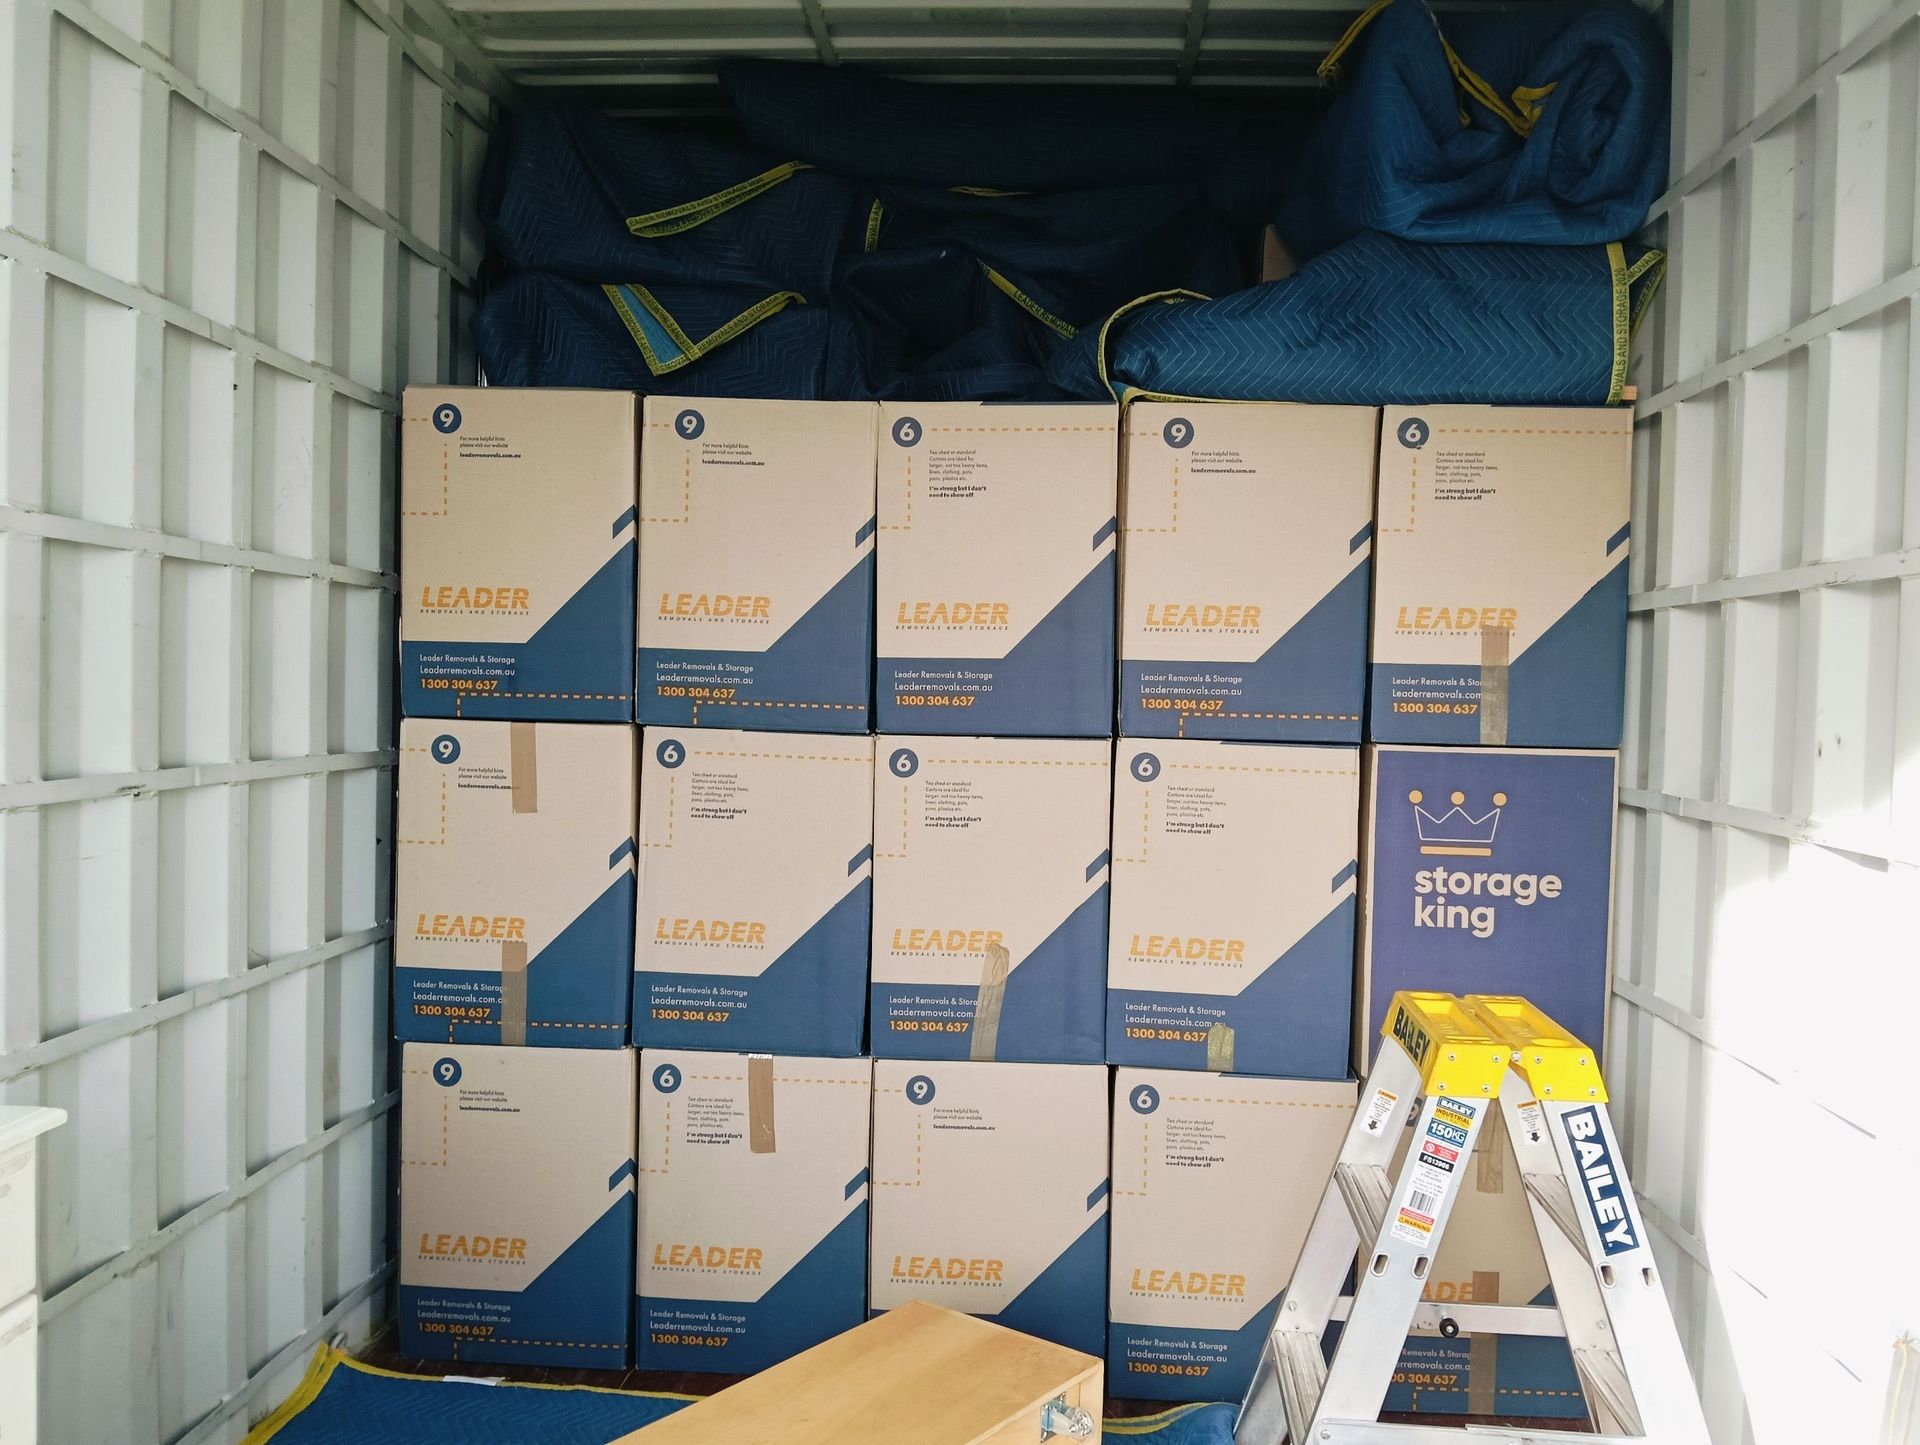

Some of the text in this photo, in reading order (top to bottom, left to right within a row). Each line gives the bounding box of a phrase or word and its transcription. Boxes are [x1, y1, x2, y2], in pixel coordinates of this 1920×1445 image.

[654, 202, 697, 220] REMOVALS
[714, 184, 748, 201] STORAGE
[1616, 267, 1628, 358] AND STORAGE 2020
[440, 409, 454, 427] 9
[683, 415, 697, 434] 9
[900, 422, 914, 441] 6
[1171, 424, 1186, 442] 9
[1406, 423, 1421, 442] 6
[422, 586, 529, 609] LEADER
[660, 593, 770, 618] LEADER
[898, 601, 1009, 625] LEADER
[1146, 604, 1261, 627] LEADER
[420, 654, 443, 662] Leader
[445, 654, 478, 663] Removals
[487, 656, 515, 665] Storage
[656, 661, 680, 670] Leader
[682, 662, 716, 671] Removals
[725, 664, 754, 674] Storage
[420, 666, 516, 676] Leaderremovals.com.au
[656, 673, 754, 684] Leaderremovals.com.au
[894, 670, 993, 681] Leader Removals & Storage
[1141, 673, 1166, 682] Leader
[1168, 674, 1203, 682] Removals
[1213, 675, 1243, 685] Storage
[421, 679, 498, 690] 1300 304 637
[657, 686, 735, 698] 1300 304 637
[895, 681, 993, 693] Leaderremovals.com.au
[1141, 685, 1243, 696] Leaderremovals.com.au
[896, 696, 975, 706] 1300 304 637
[1142, 699, 1223, 710] 1300 304 637
[1393, 703, 1478, 714] 1300 304 637
[439, 740, 453, 758] 9
[664, 744, 678, 763] 6
[897, 754, 911, 772] 6
[1138, 758, 1153, 776] 6
[1414, 866, 1562, 906] storage
[1414, 896, 1495, 938] king
[417, 914, 525, 938] LEADER
[657, 918, 766, 943] LEADER
[1131, 934, 1244, 962] LEADER
[651, 984, 675, 993] Leader
[677, 986, 711, 995] Removals
[720, 988, 748, 998] Storage
[651, 996, 748, 1009] Leaderremovals.com.au
[1125, 1002, 1226, 1018] Leader Removals & Storage
[414, 1005, 490, 1017] 1300 304 637
[652, 1009, 729, 1022] 1300 304 637
[890, 1021, 969, 1032] 1300 304 637
[1126, 1028, 1207, 1042] 1300 304 637
[1392, 1005, 1431, 1067] BAILEY
[440, 1063, 454, 1081] 9
[660, 1069, 674, 1088] 6
[913, 1081, 928, 1099] 9
[1137, 1089, 1152, 1109] 6
[1440, 1100, 1472, 1116] BAILEY
[1436, 1108, 1470, 1125] INDUSTRIAL
[1430, 1122, 1465, 1141] 150KG
[1568, 1112, 1634, 1247] BAILEY
[1404, 1219, 1430, 1233] WARNING
[420, 1233, 526, 1259] LEADER
[654, 1244, 762, 1269] LEADER
[893, 1256, 1003, 1281] LEADER
[1132, 1268, 1246, 1296] LEADER
[417, 1298, 511, 1313] Leader Removals & Storage
[417, 1309, 511, 1323] Leaderremovals.com.au
[650, 1310, 674, 1318] Leader
[676, 1311, 709, 1320] Removals
[718, 1313, 746, 1324] Storage
[418, 1322, 494, 1336] 1300 304 637
[650, 1321, 746, 1334] Leaderremovals.com.au
[651, 1334, 728, 1346] 1300 304 637
[1127, 1338, 1228, 1352] Leader Removals & Storage
[1127, 1349, 1228, 1363] Leaderremovals.com.au
[1128, 1362, 1209, 1376] 1300 304 637
[1408, 1374, 1457, 1384] 304 637
